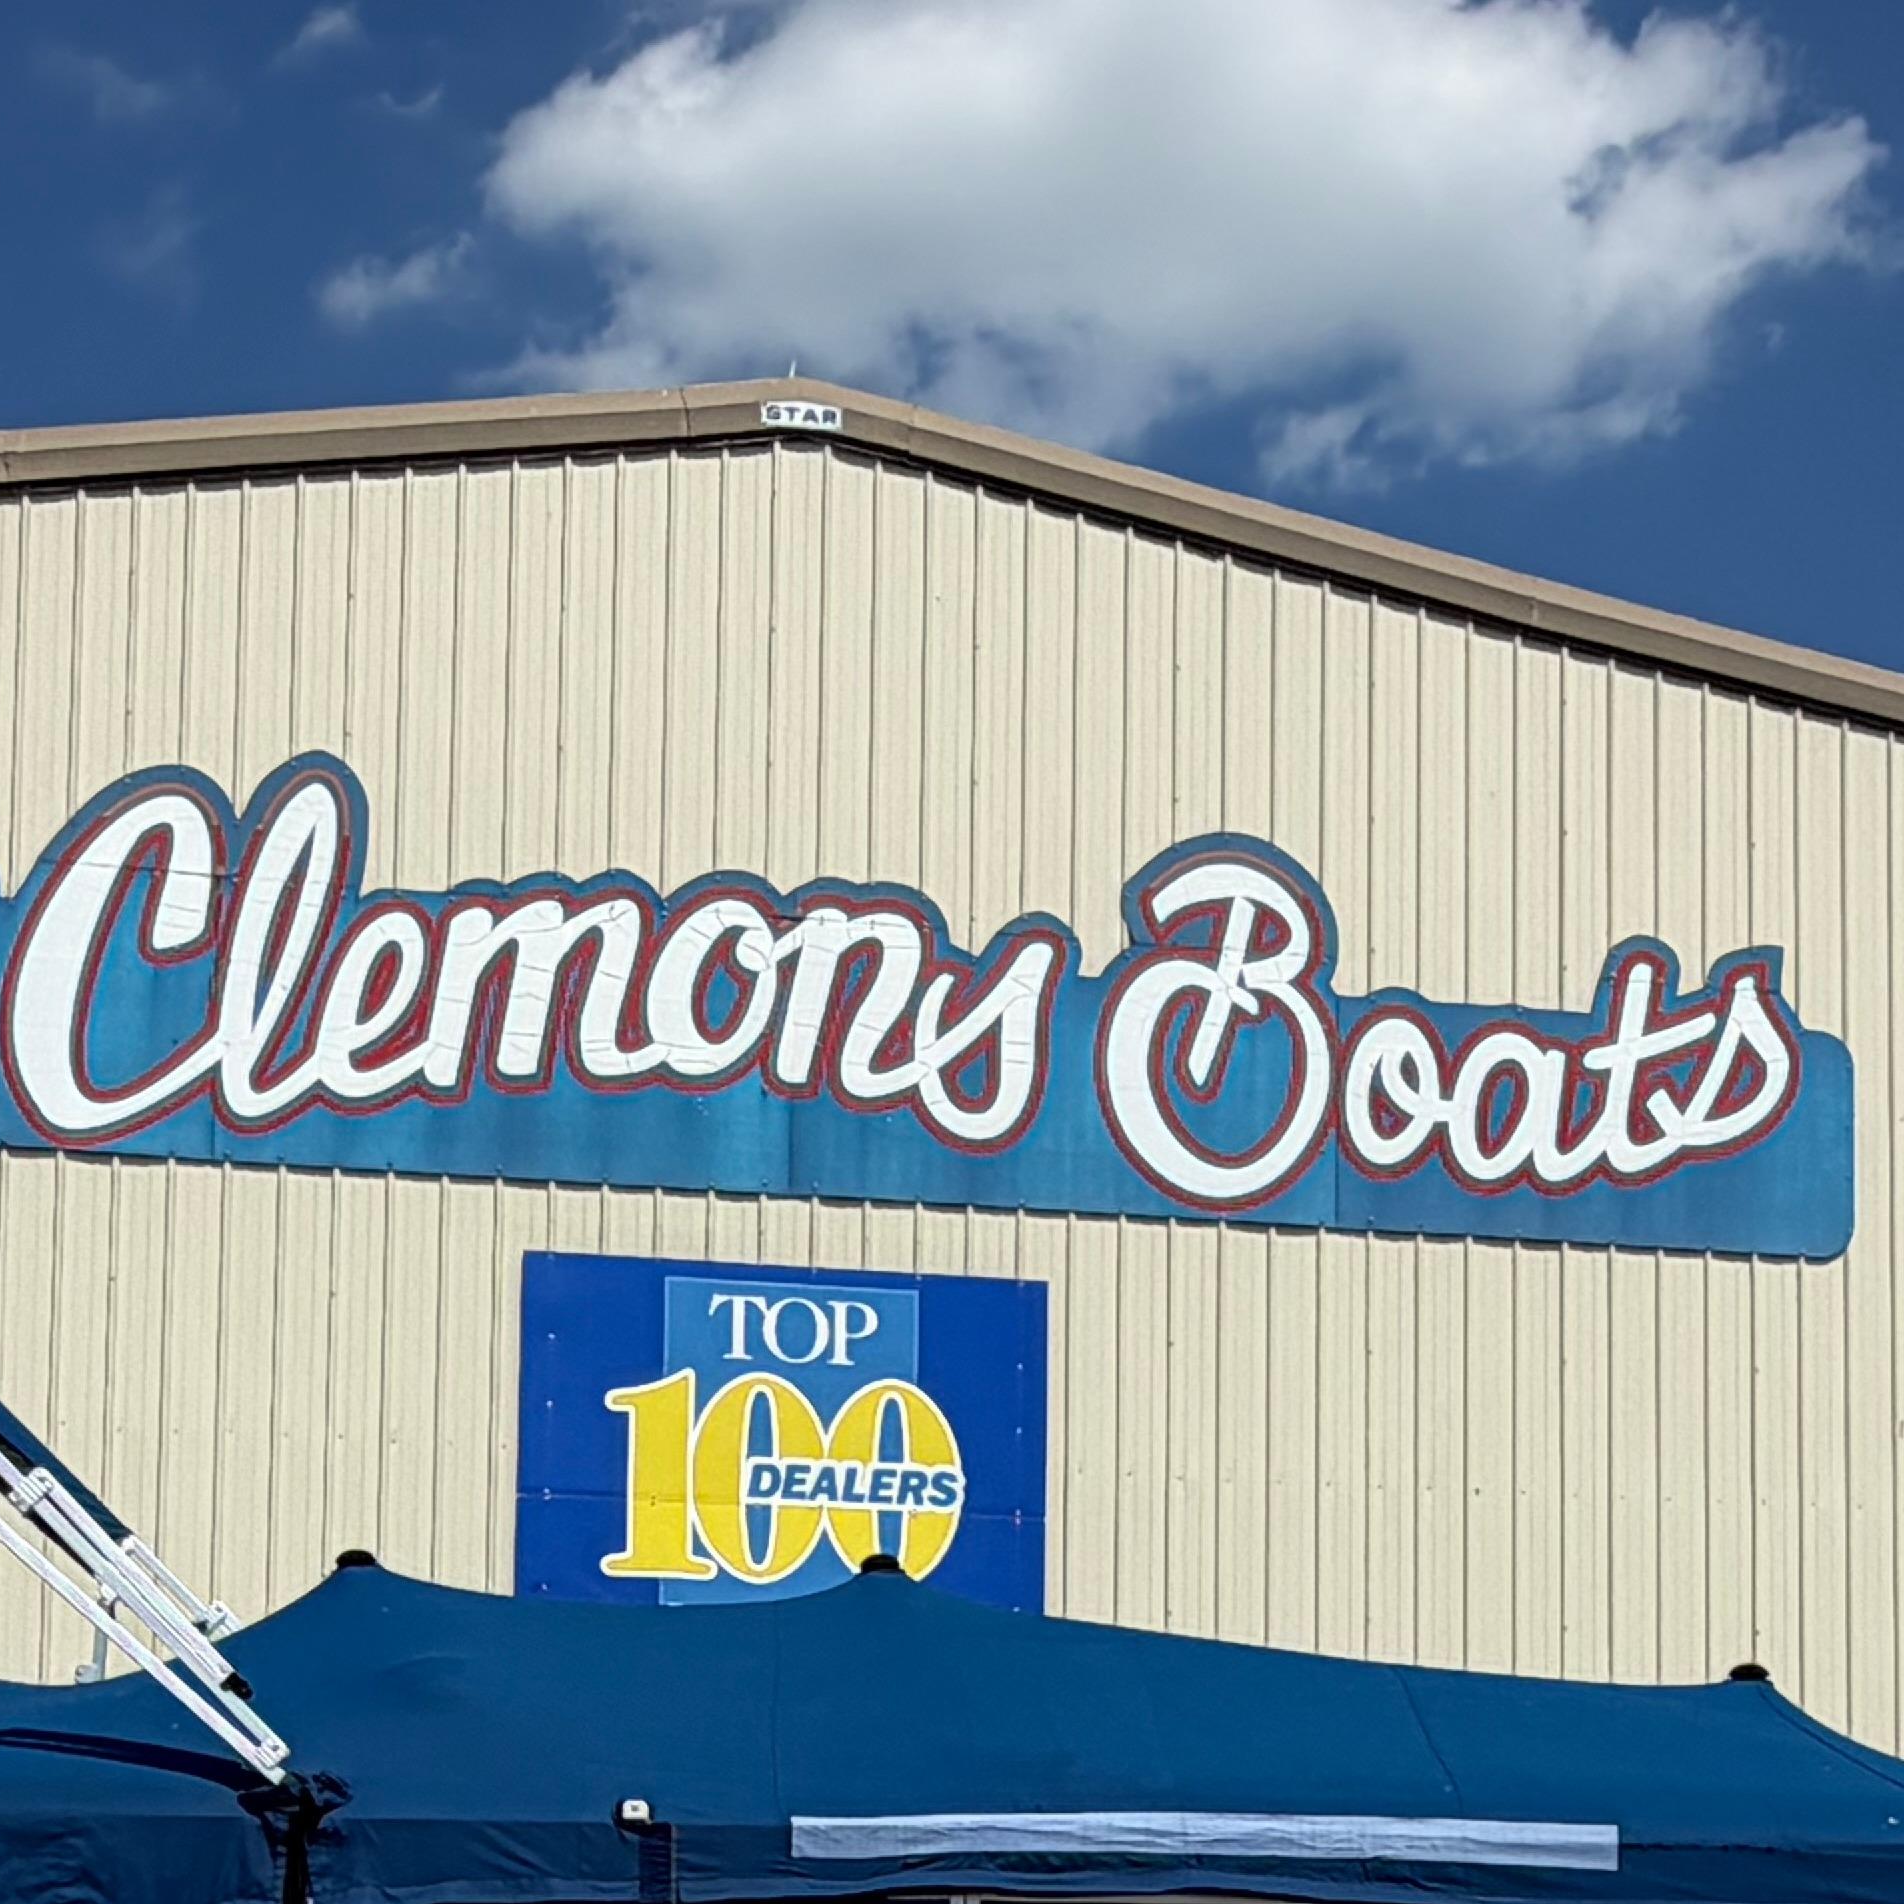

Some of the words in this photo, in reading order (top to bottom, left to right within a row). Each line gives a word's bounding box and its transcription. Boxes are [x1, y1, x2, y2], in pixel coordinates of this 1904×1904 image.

[766, 404, 837, 424] STAR
[7, 776, 1058, 1146] Clemons
[1103, 858, 1792, 1204] Boats
[708, 1293, 879, 1366] TOP
[599, 1367, 964, 1584] 100
[747, 1462, 958, 1508] DEALERS
